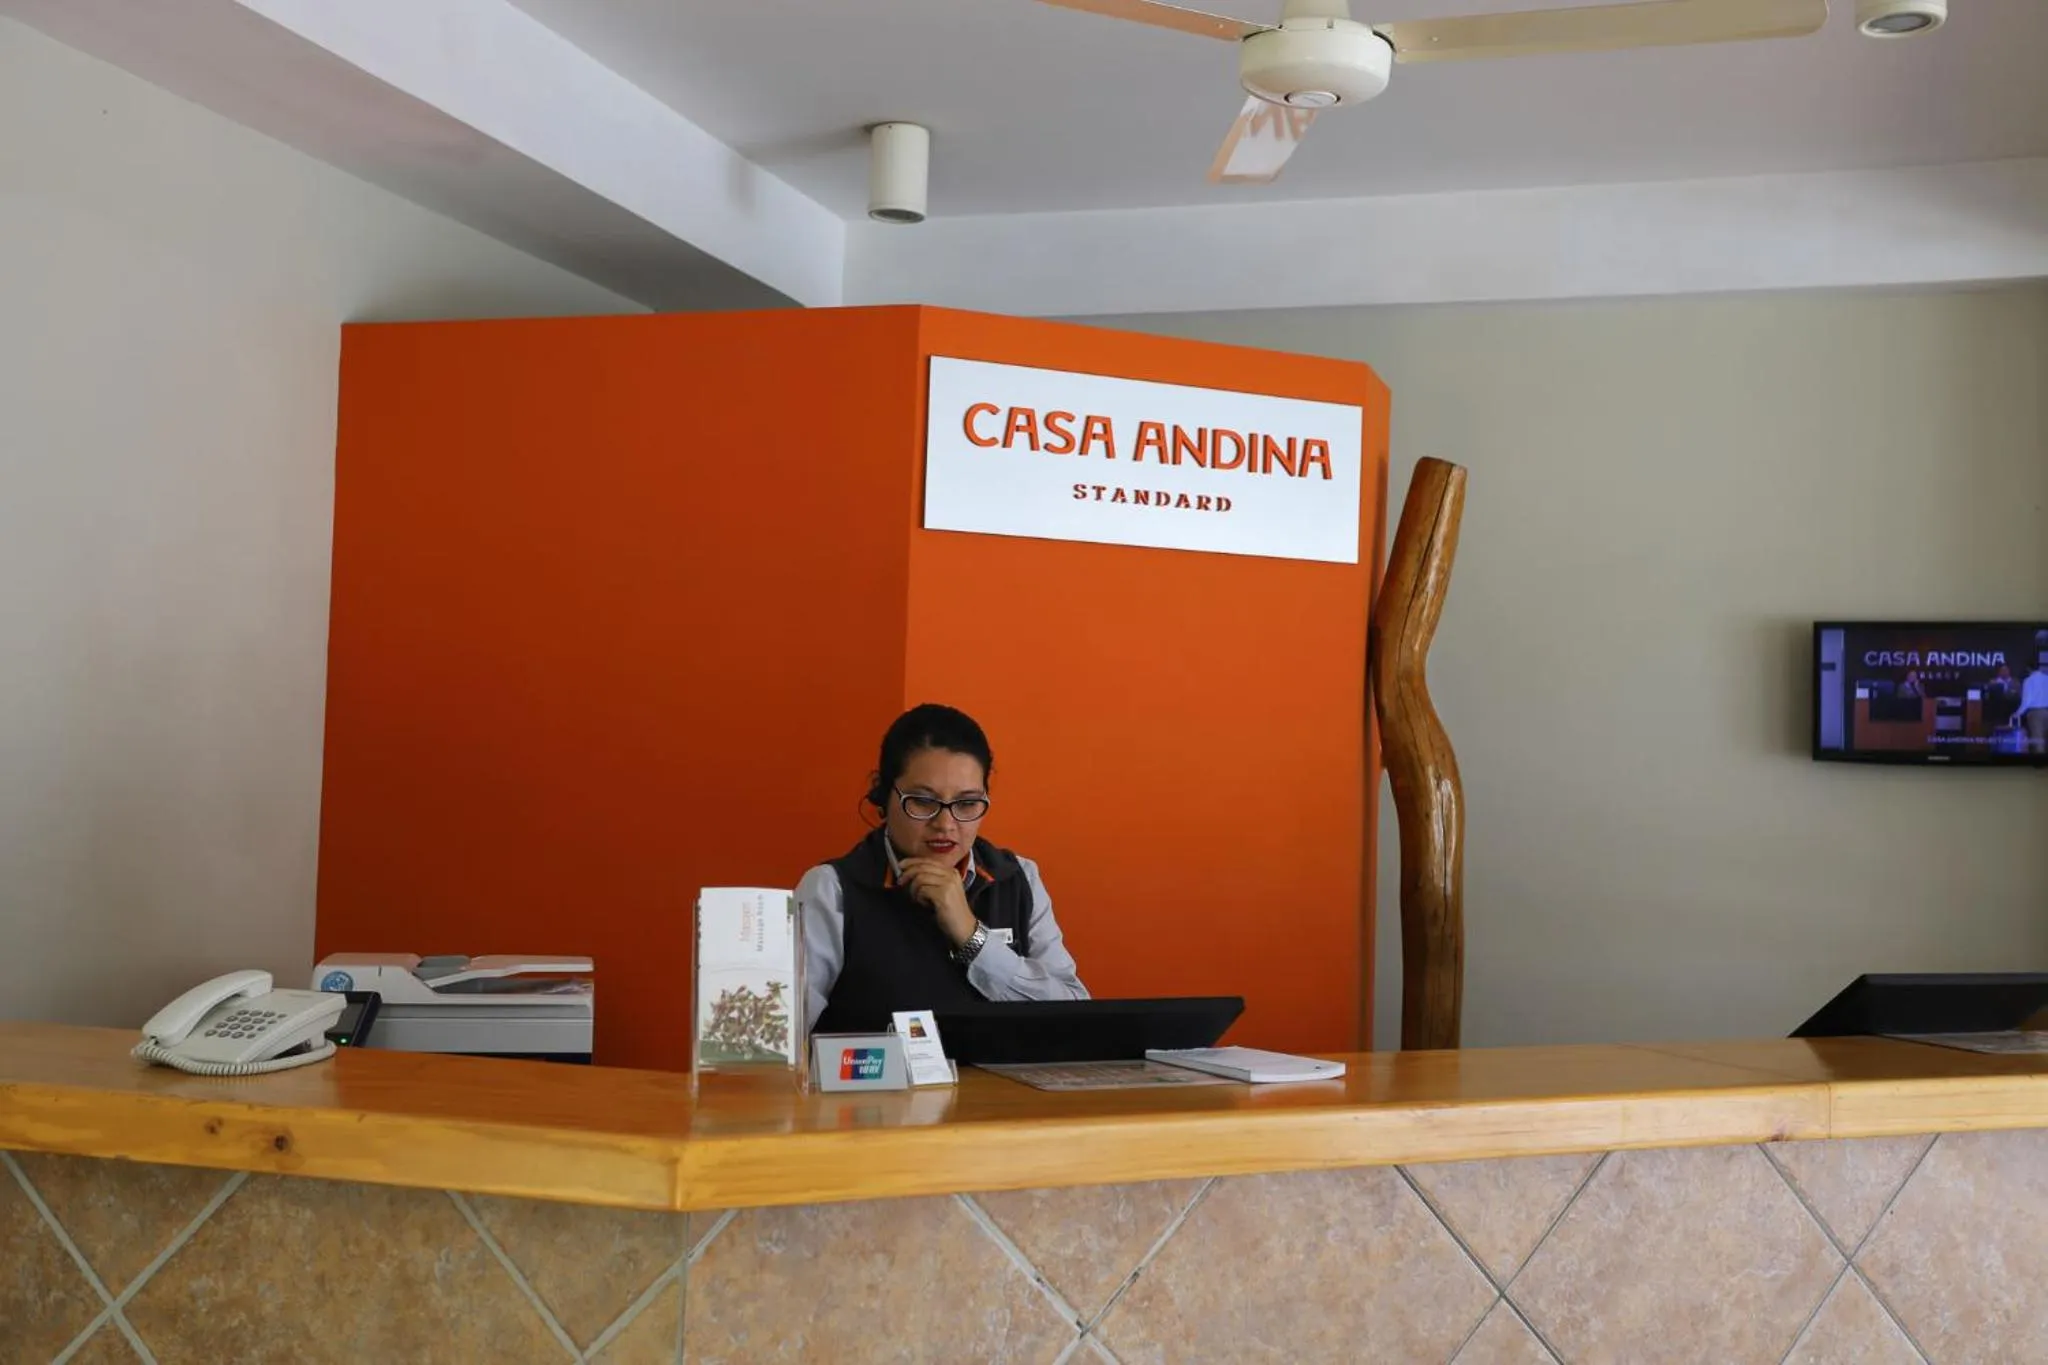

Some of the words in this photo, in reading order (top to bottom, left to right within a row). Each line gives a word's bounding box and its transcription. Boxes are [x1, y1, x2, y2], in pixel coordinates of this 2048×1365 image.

[963, 402, 1116, 458] CASA
[1133, 421, 1333, 480] ANDINA
[1073, 483, 1233, 513] STANDARD
[1864, 651, 1920, 666] CASA
[1926, 651, 2005, 667] ANDINA
